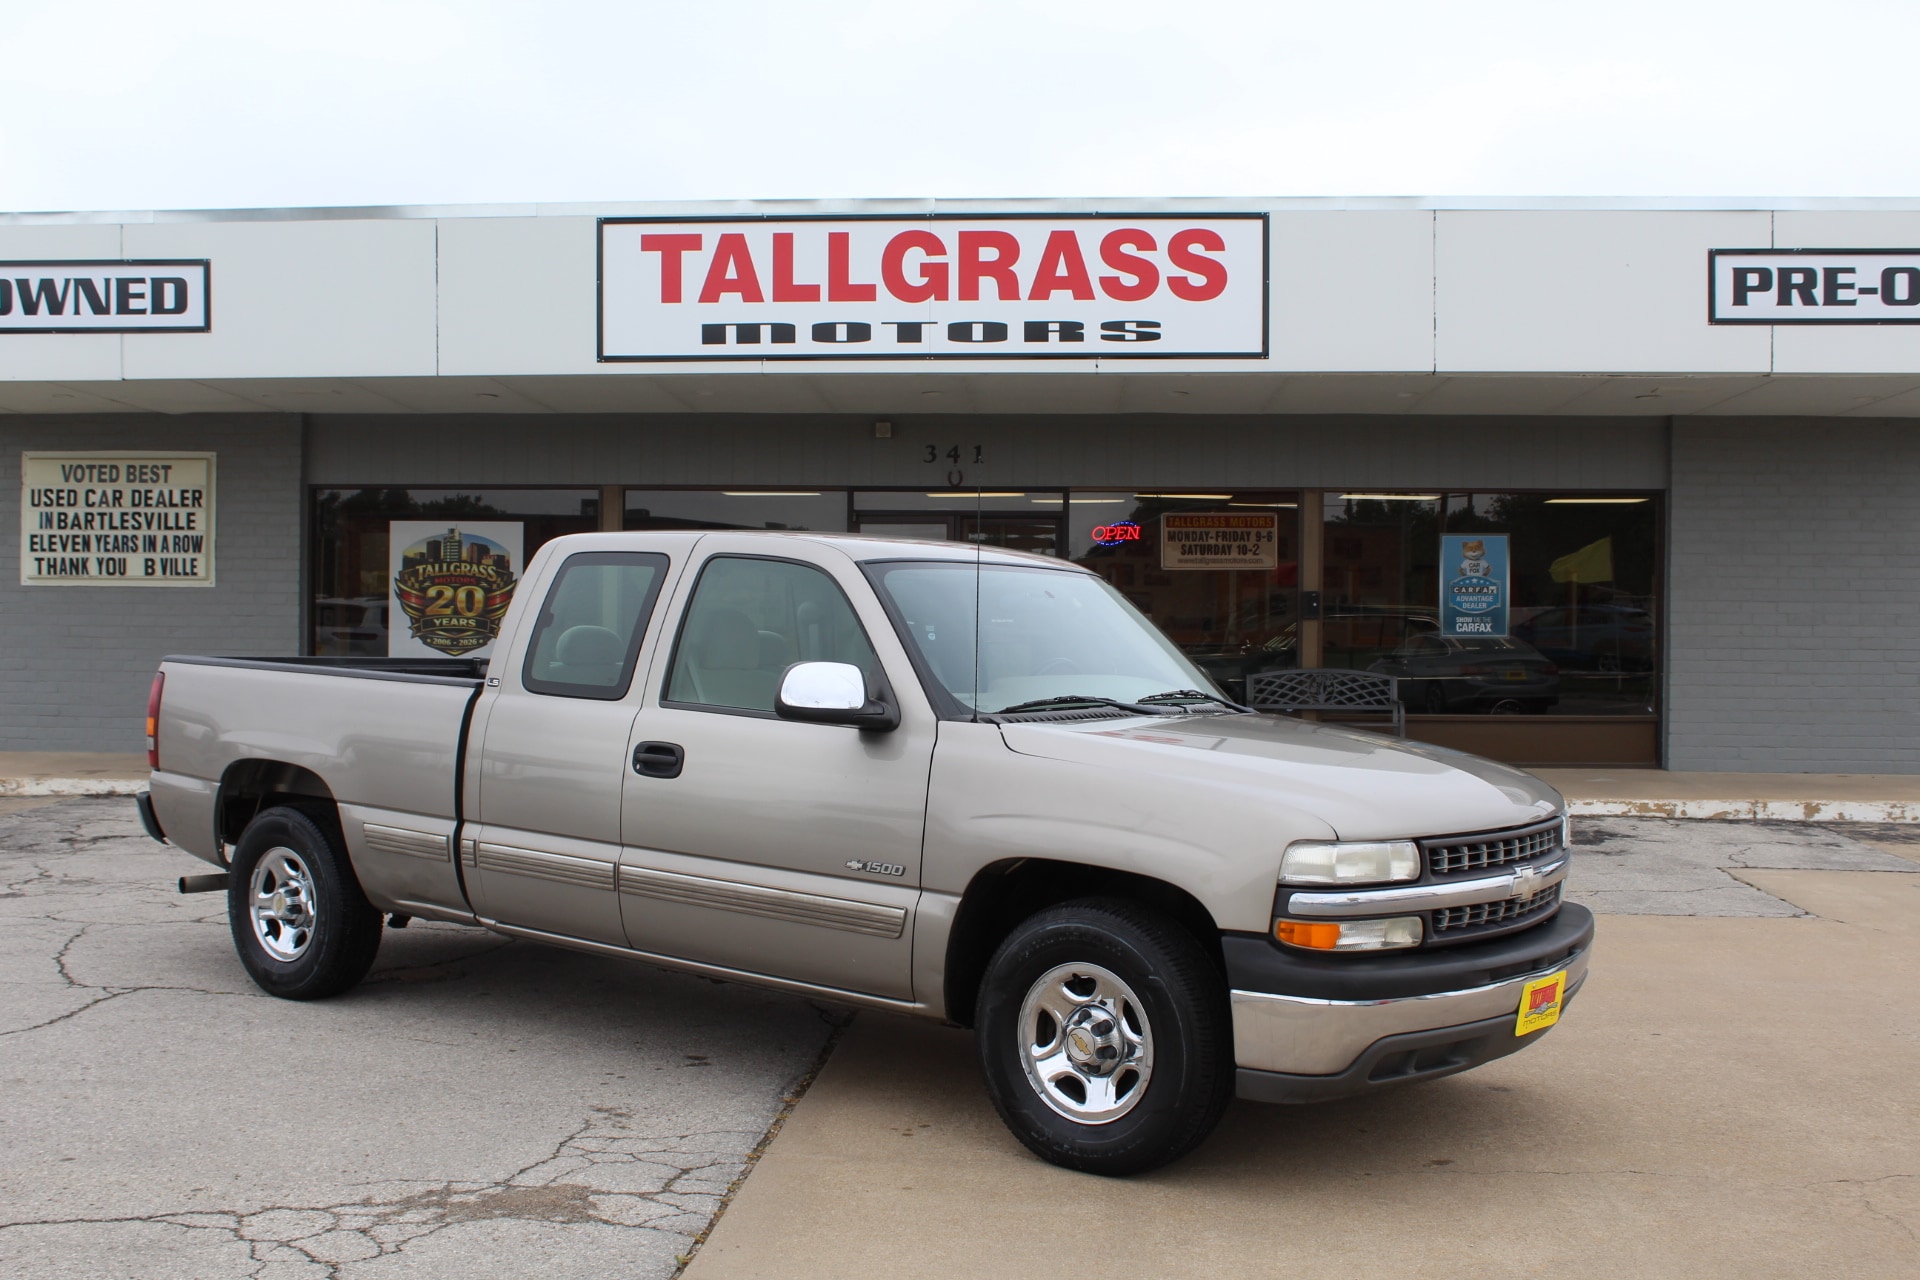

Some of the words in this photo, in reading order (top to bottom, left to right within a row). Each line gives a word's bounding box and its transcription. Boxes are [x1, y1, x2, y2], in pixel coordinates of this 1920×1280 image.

[640, 228, 1228, 304] TALLGRASS
[701, 320, 1162, 345] MOTORS
[922, 444, 985, 464] 341
[61, 464, 120, 484] VOTED
[125, 464, 173, 484] BEST
[30, 488, 78, 508] USED
[84, 489, 123, 508] CAR
[130, 489, 203, 508] DEALER
[39, 511, 53, 530] IN
[56, 512, 197, 531] BARTLESVILLE
[1168, 516, 1226, 527] TALLGRASS
[1230, 516, 1273, 527] MOTORS
[1092, 526, 1142, 540] OPEN
[1255, 530, 1273, 542] 9-6
[29, 534, 91, 553] ELEVEN
[94, 534, 139, 553] YEARS
[142, 535, 157, 553] IN
[160, 535, 170, 553] A
[172, 534, 204, 553] ROW
[1180, 543, 1233, 555] SATURDAY
[1236, 543, 1260, 555] 10-2
[34, 557, 90, 576] THANK
[96, 557, 127, 576] YOU
[144, 558, 156, 577] B
[160, 557, 198, 577] VILLE
[415, 562, 497, 582] TALLGRASS
[425, 586, 485, 617] 20
[433, 618, 476, 628] YEARS
[1456, 623, 1492, 632] CARFAX
[865, 861, 905, 876] 1500
